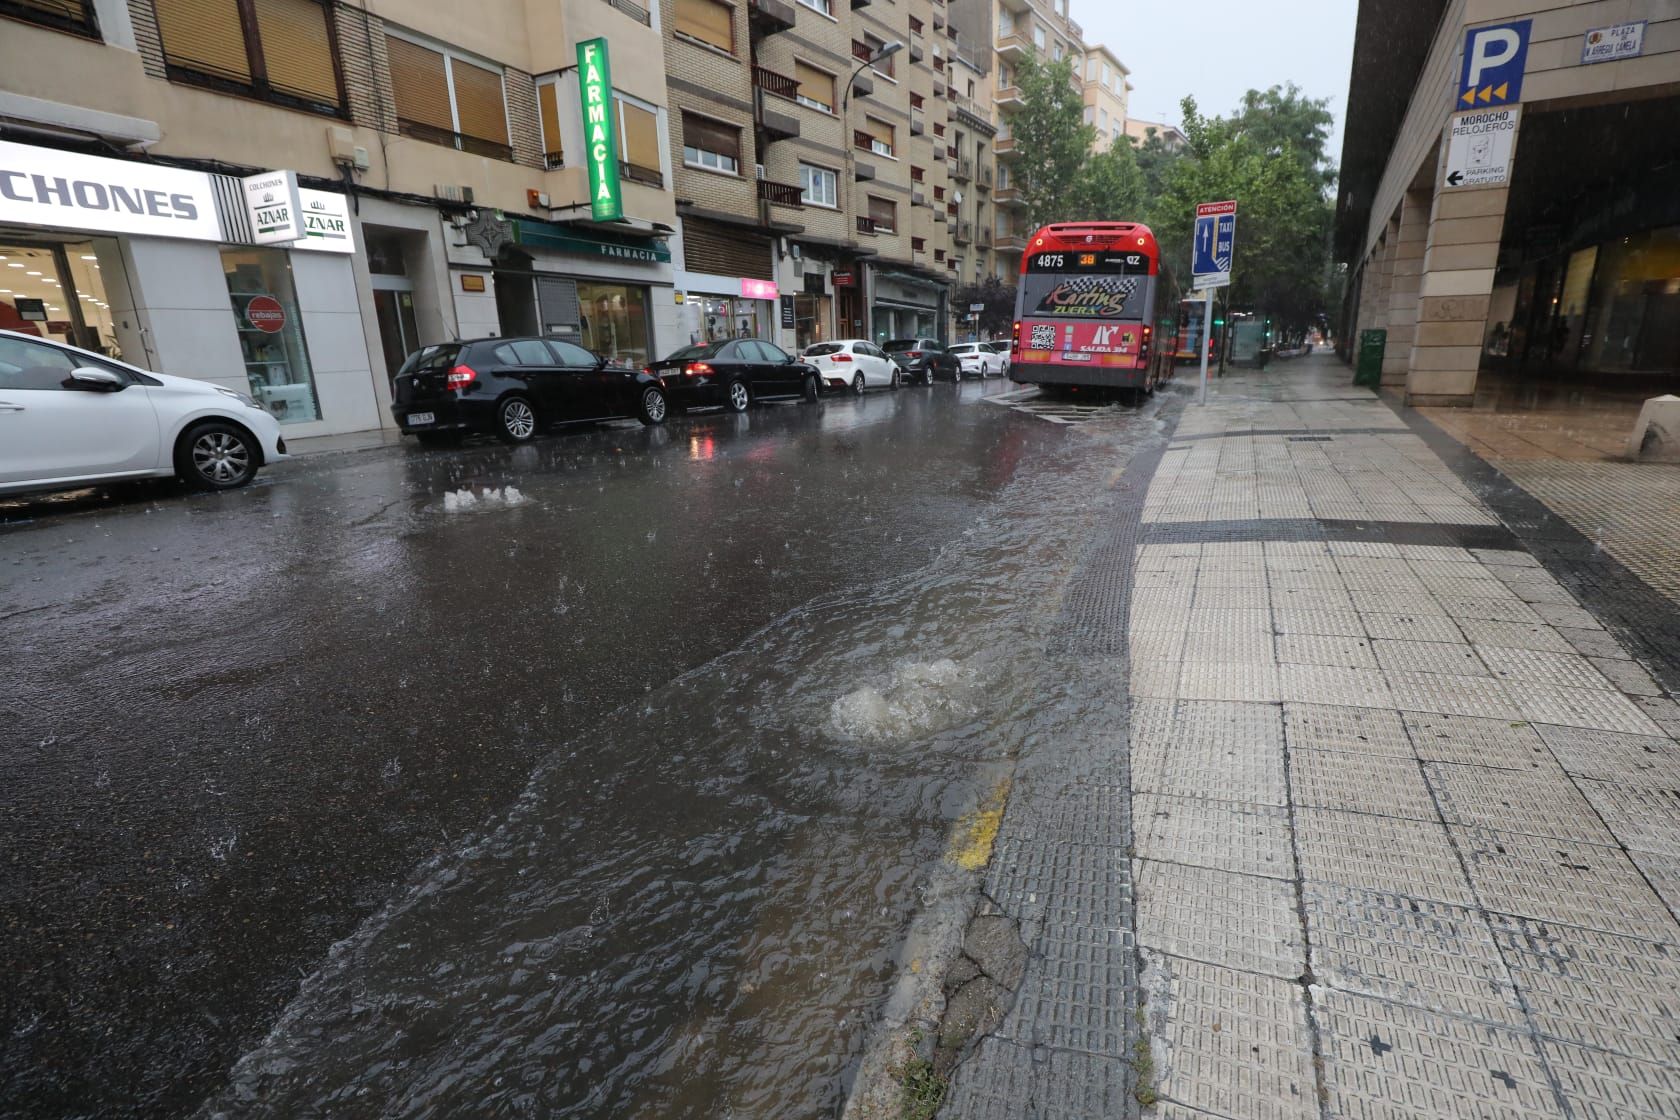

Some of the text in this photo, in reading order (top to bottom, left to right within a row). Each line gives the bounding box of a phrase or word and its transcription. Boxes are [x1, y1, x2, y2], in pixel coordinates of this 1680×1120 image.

[1611, 27, 1635, 36] PLAZA
[1467, 28, 1520, 87] P
[584, 44, 611, 200] FARMACIA
[1460, 111, 1509, 126] MOROCHO
[1452, 121, 1514, 136] RELOJEROS
[1466, 167, 1504, 176] PARKING
[249, 179, 283, 191] COLCHONES
[1463, 175, 1505, 185] GRATUITO
[1199, 203, 1234, 213] ATENCIÓN
[257, 208, 289, 225] AZNAR
[1219, 222, 1233, 233] TAXI
[1218, 241, 1230, 252] BUS
[600, 245, 657, 262] FARMACIA
[1038, 255, 1064, 267] 4875
[1045, 281, 1127, 316] Karting
[251, 311, 283, 320] rebajas
[1052, 305, 1096, 315] ZUERA
[1080, 345, 1111, 353] SALIDA
